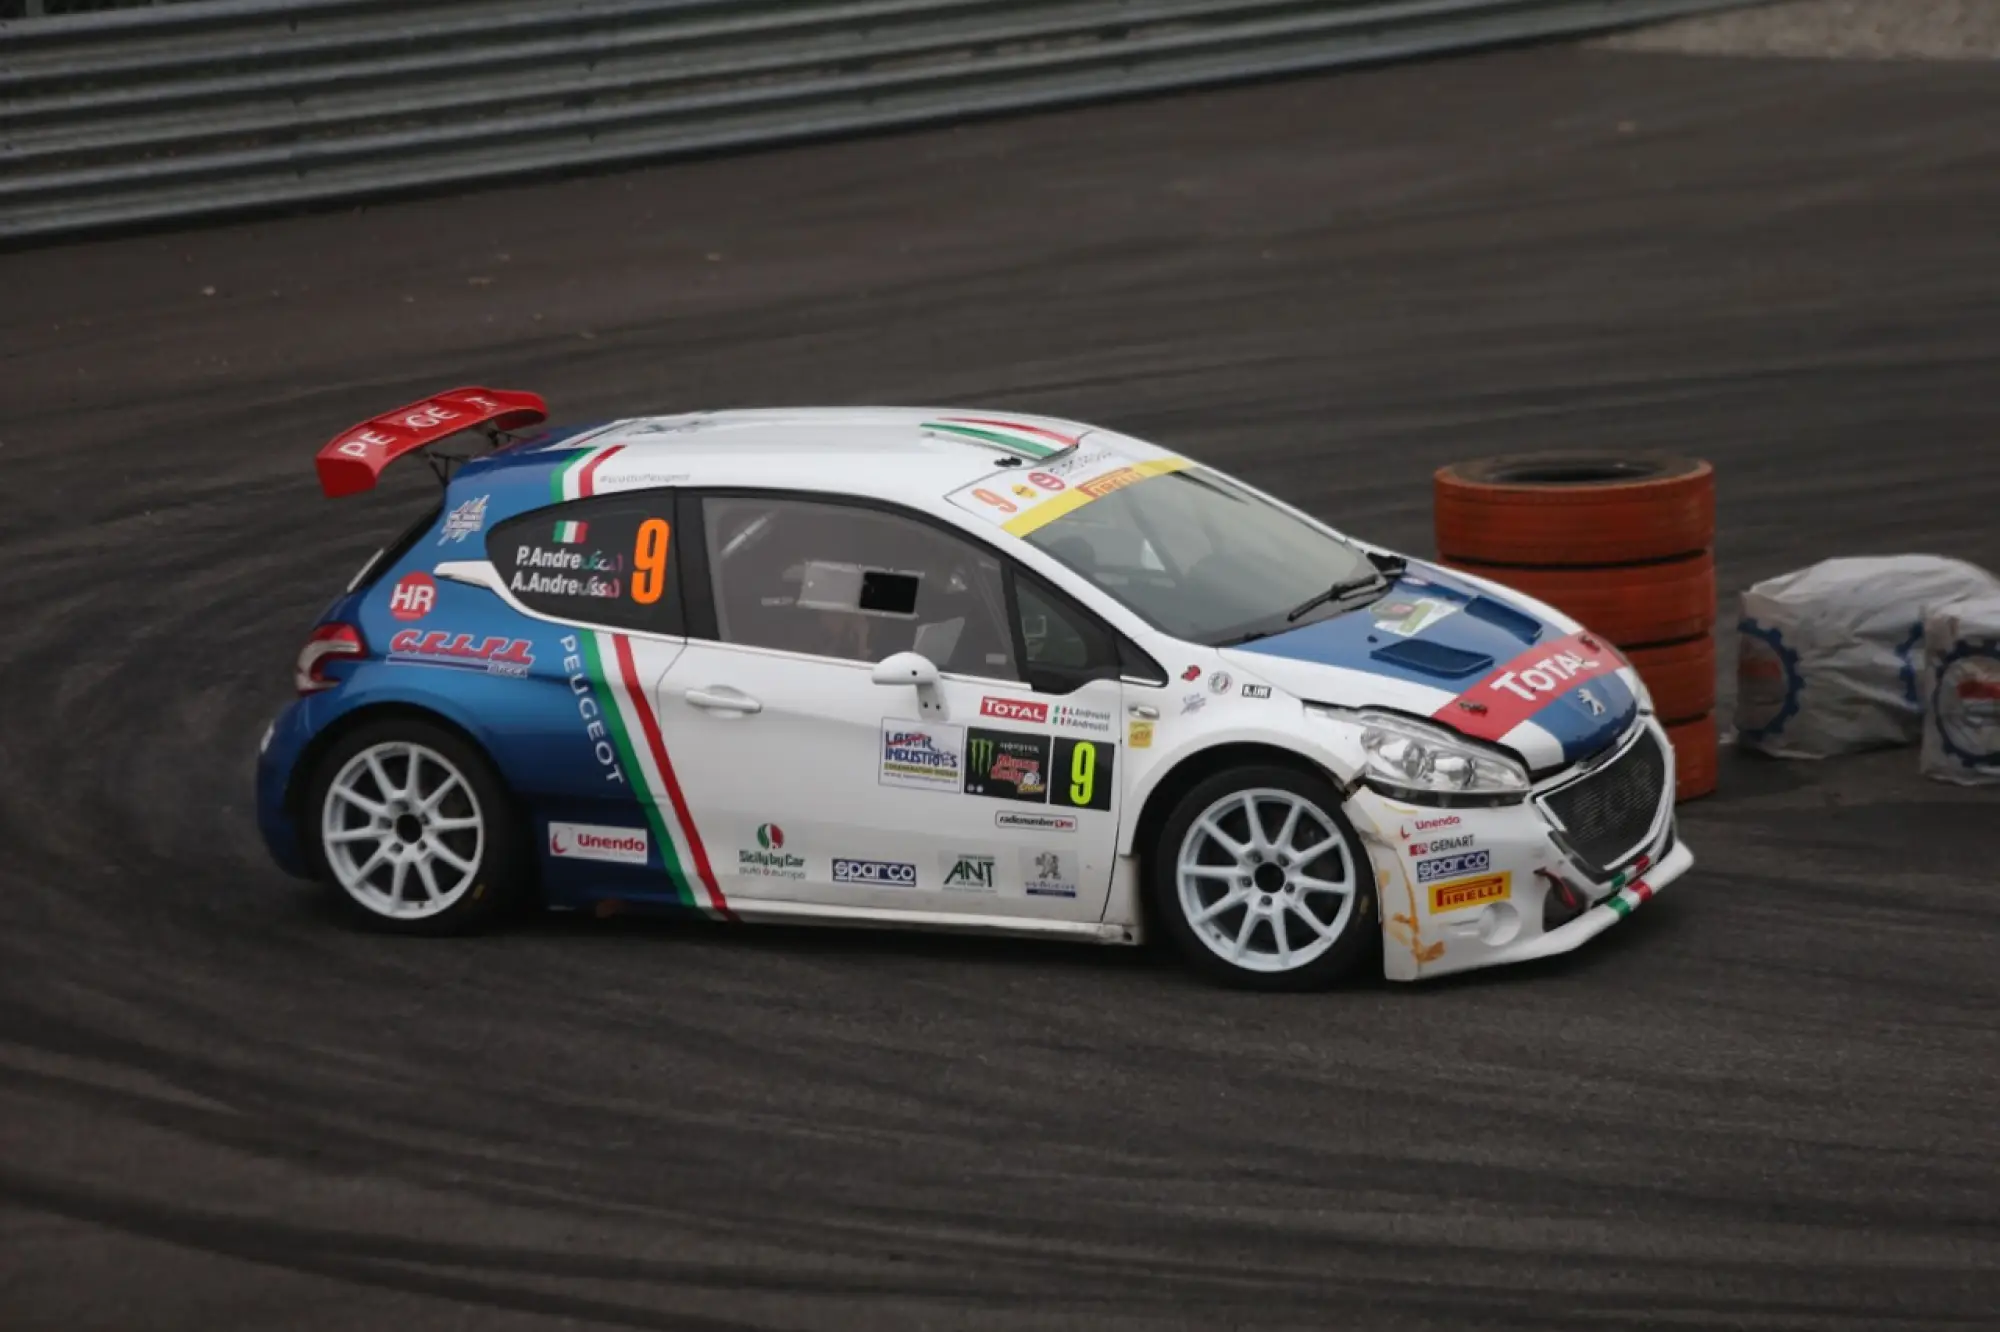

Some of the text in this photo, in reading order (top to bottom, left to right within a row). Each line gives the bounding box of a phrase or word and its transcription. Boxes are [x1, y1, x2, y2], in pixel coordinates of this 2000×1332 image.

[631, 517, 670, 604] 9
[390, 583, 435, 612] HR
[1489, 651, 1599, 701] TOTAL
[560, 634, 624, 784] PEUGEOT
[985, 699, 1045, 720] TOTAL
[1070, 741, 1095, 805] 9
[1415, 816, 1461, 830] Unendo
[577, 832, 645, 852] Unendo
[1430, 835, 1475, 853] GENART
[834, 861, 914, 883] sparco
[943, 859, 994, 888] ANT
[1419, 852, 1487, 881] sparco
[1436, 876, 1503, 908] PIRELLI
